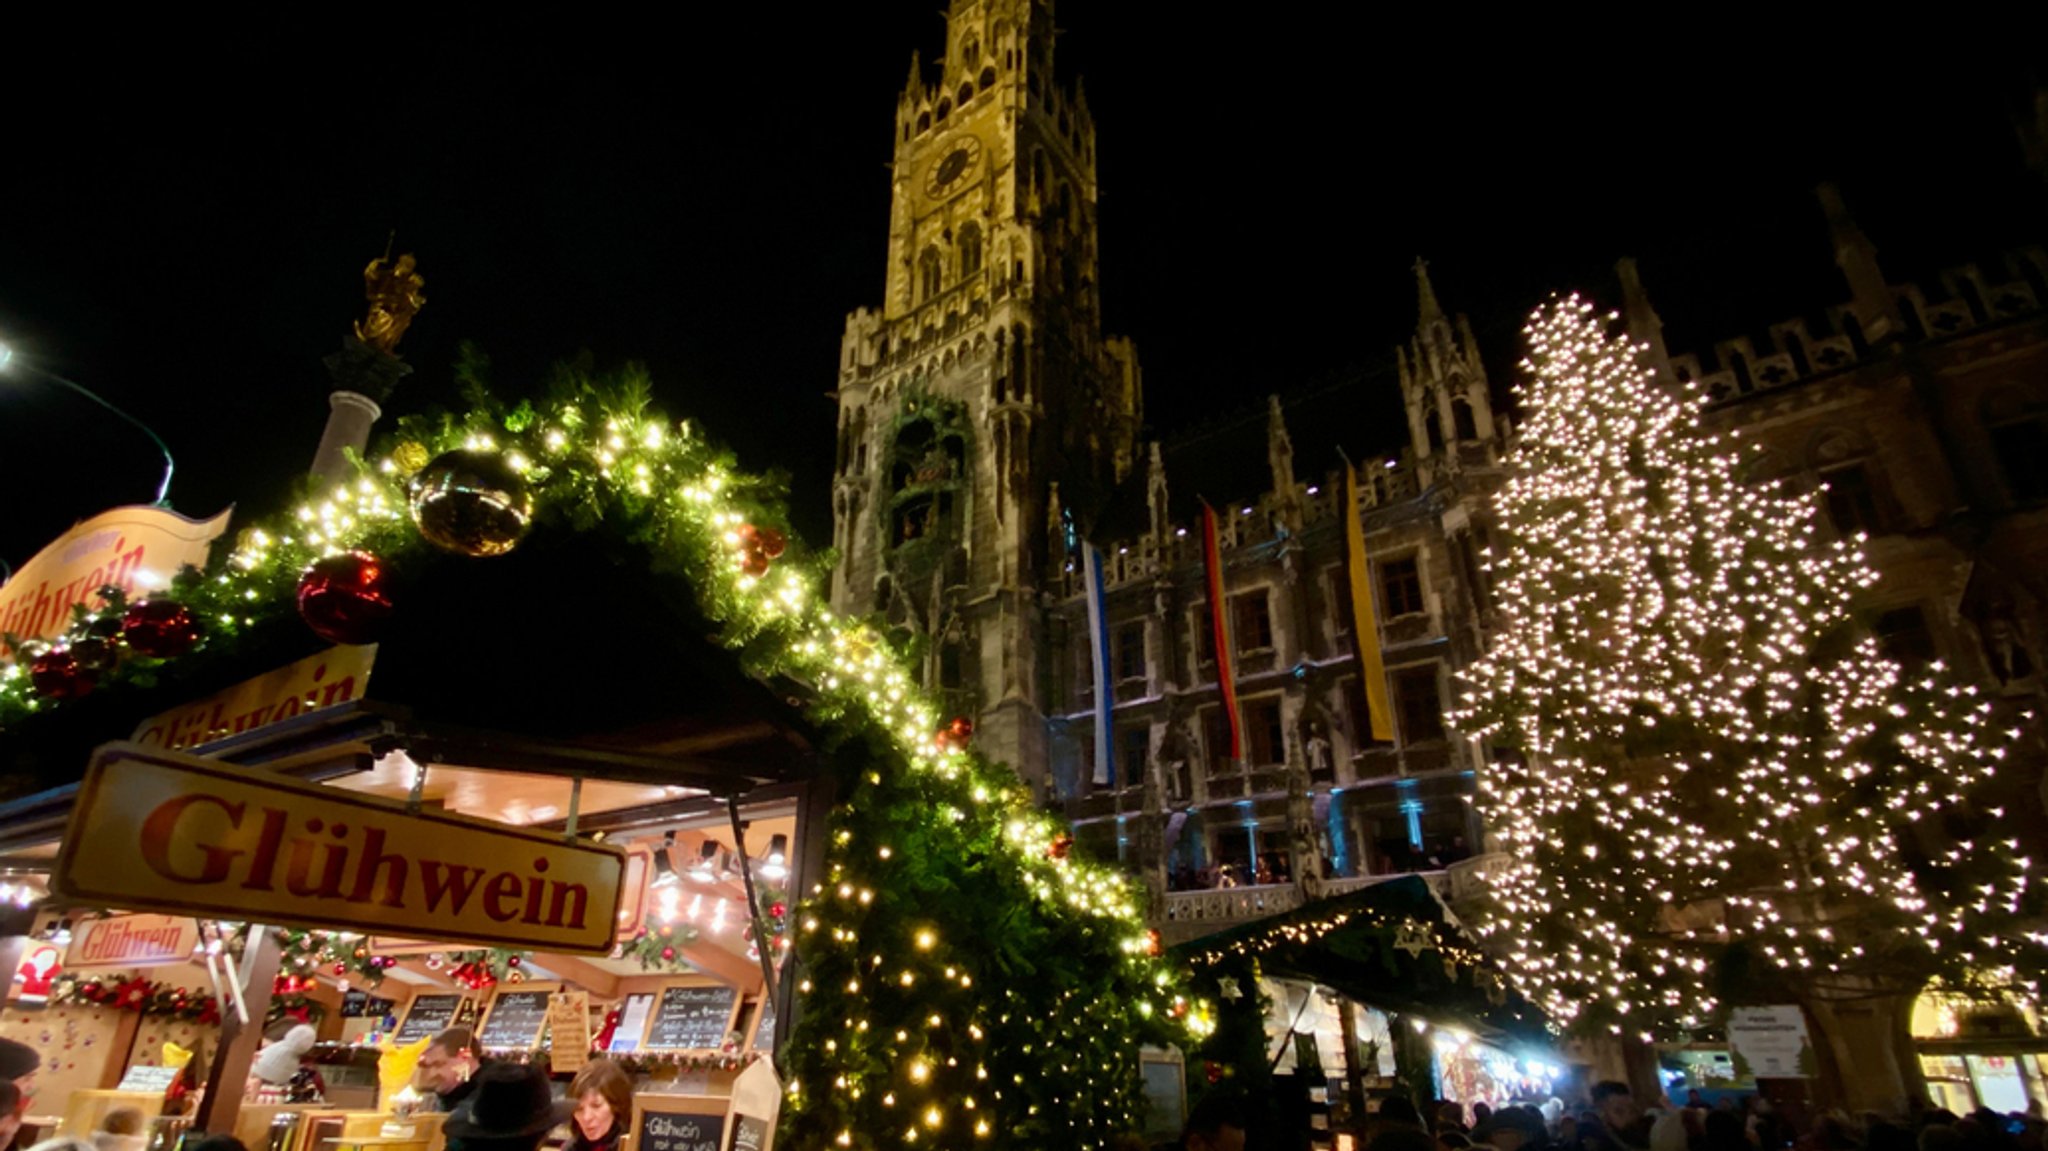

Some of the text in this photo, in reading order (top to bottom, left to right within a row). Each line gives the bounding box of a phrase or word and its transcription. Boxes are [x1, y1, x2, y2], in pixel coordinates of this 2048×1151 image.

[140, 793, 588, 930] Glühwein
[82, 915, 183, 961] Glühwein
[649, 1116, 701, 1140] Glühwein
